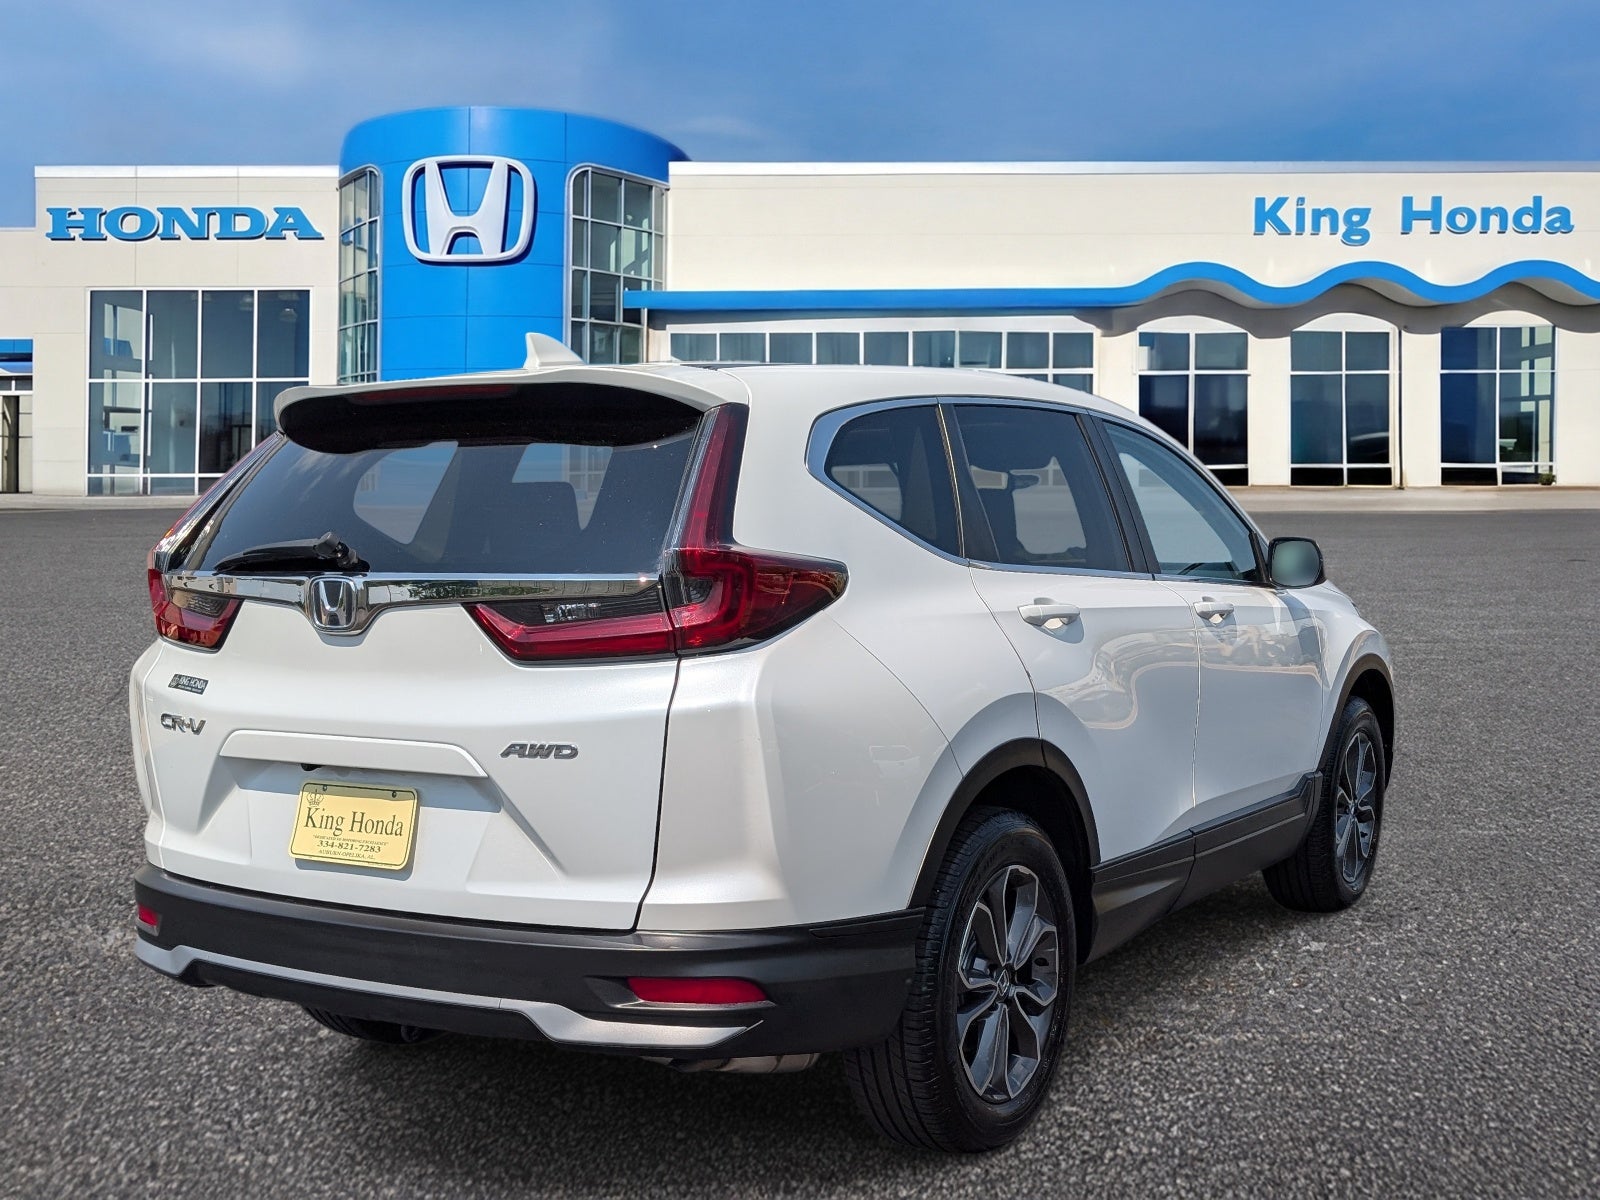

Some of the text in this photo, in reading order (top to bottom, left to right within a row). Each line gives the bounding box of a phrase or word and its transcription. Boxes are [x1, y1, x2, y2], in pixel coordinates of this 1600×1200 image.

[46, 206, 325, 241] HONDA
[1253, 195, 1575, 247] King Honda
[160, 713, 207, 735] CR-V
[500, 743, 579, 760] AWD
[304, 806, 404, 837] King Honda
[317, 840, 381, 853] 334-821-7283
